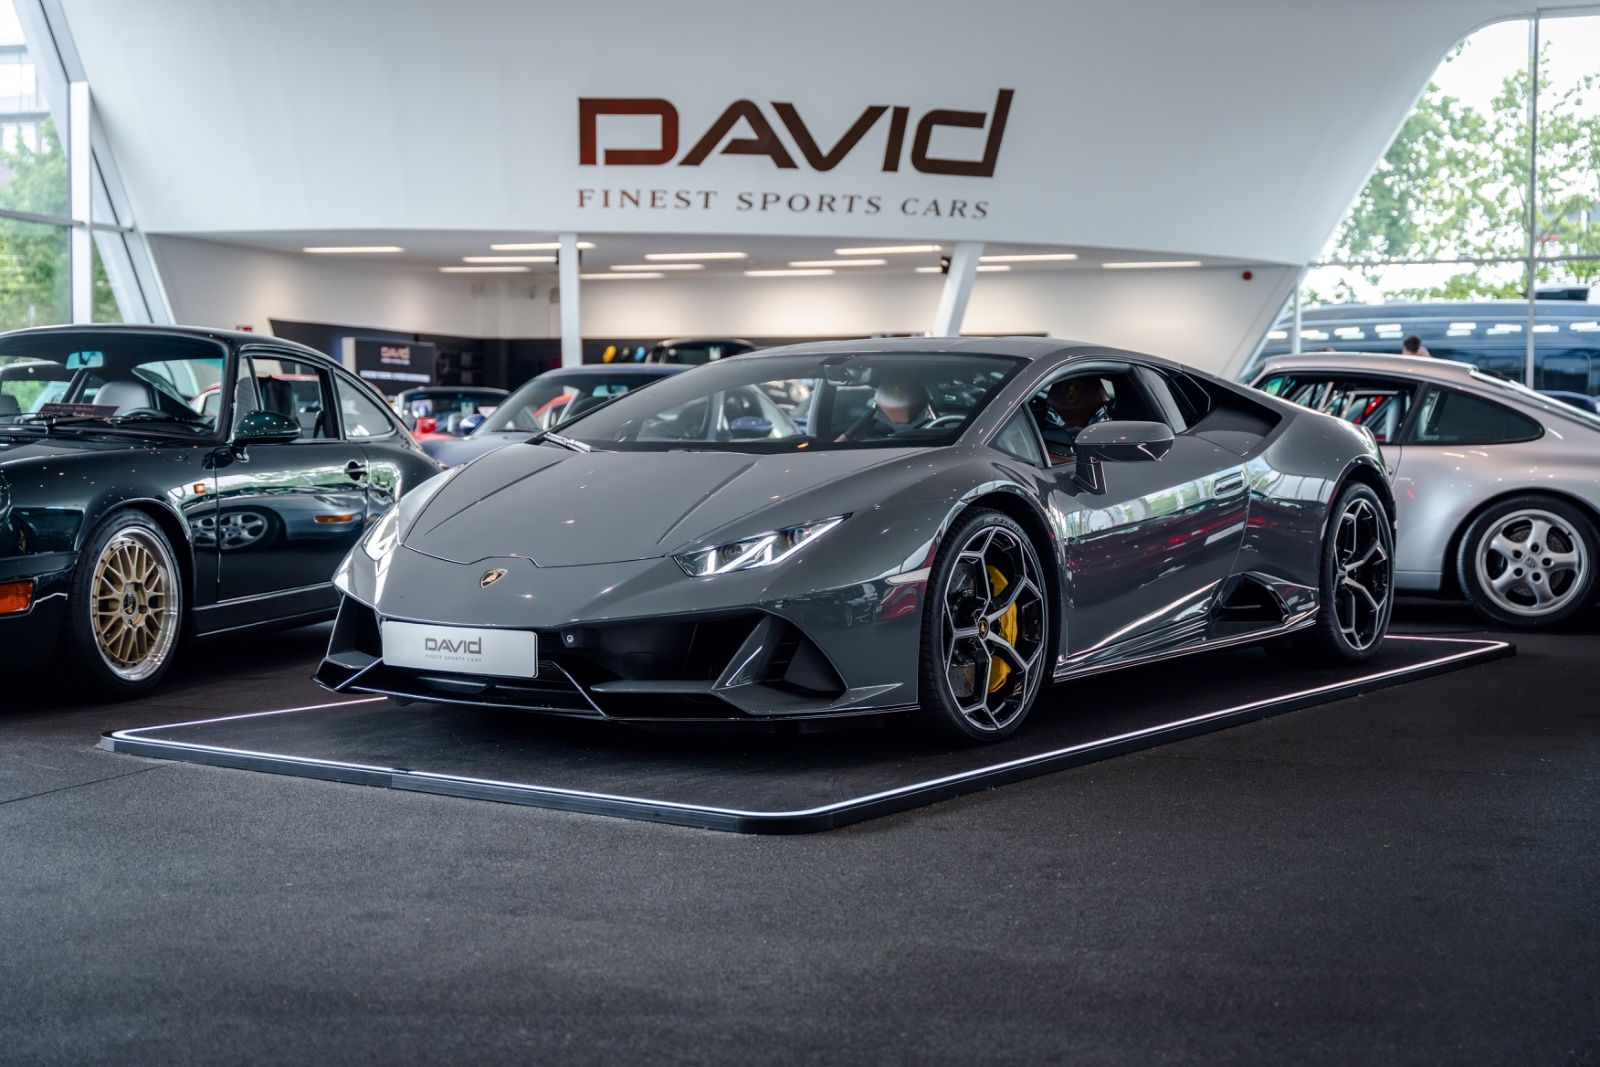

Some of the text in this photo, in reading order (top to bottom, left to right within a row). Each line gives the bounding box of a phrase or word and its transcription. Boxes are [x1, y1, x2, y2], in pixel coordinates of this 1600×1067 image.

[577, 189, 989, 219] FINEST SPORTS CARS
